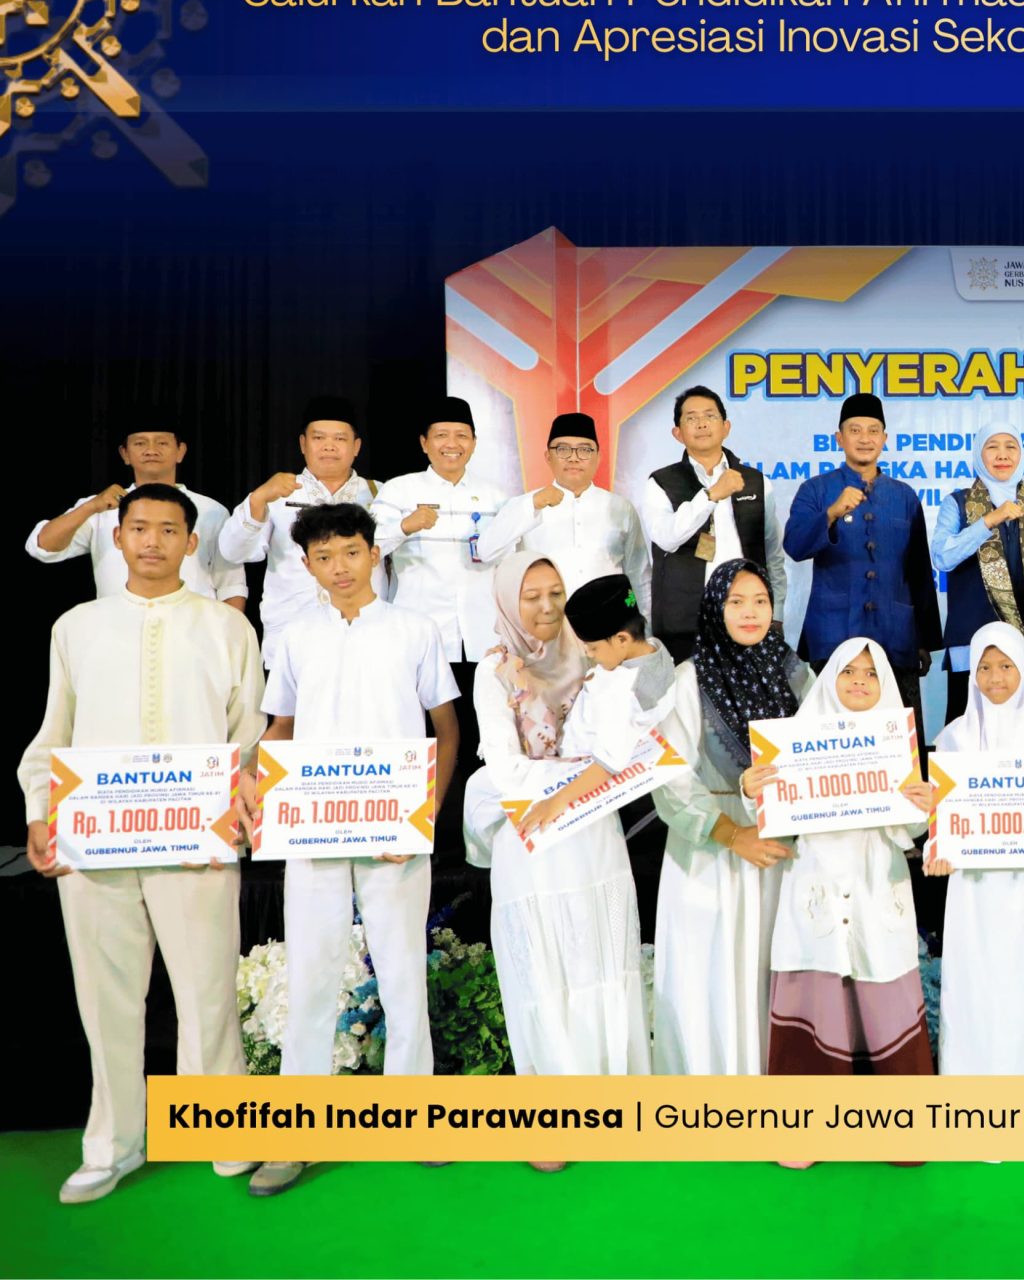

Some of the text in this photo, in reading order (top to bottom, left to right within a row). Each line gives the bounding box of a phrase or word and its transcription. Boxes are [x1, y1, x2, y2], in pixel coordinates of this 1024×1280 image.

[792, 736, 875, 753] BANTUAN
[97, 771, 192, 785] BANTUAN
[302, 764, 391, 777] BANTUAN
[777, 770, 898, 804] Rp. 1.000.000,-
[278, 799, 409, 828] Rp. 1.000.000,-
[791, 812, 837, 821] GUBERNUR
[840, 809, 863, 817] JAWA
[73, 807, 212, 838] Rp. 1.000.000,-
[951, 813, 974, 839] Rp.
[85, 847, 137, 855] GUBERNUR
